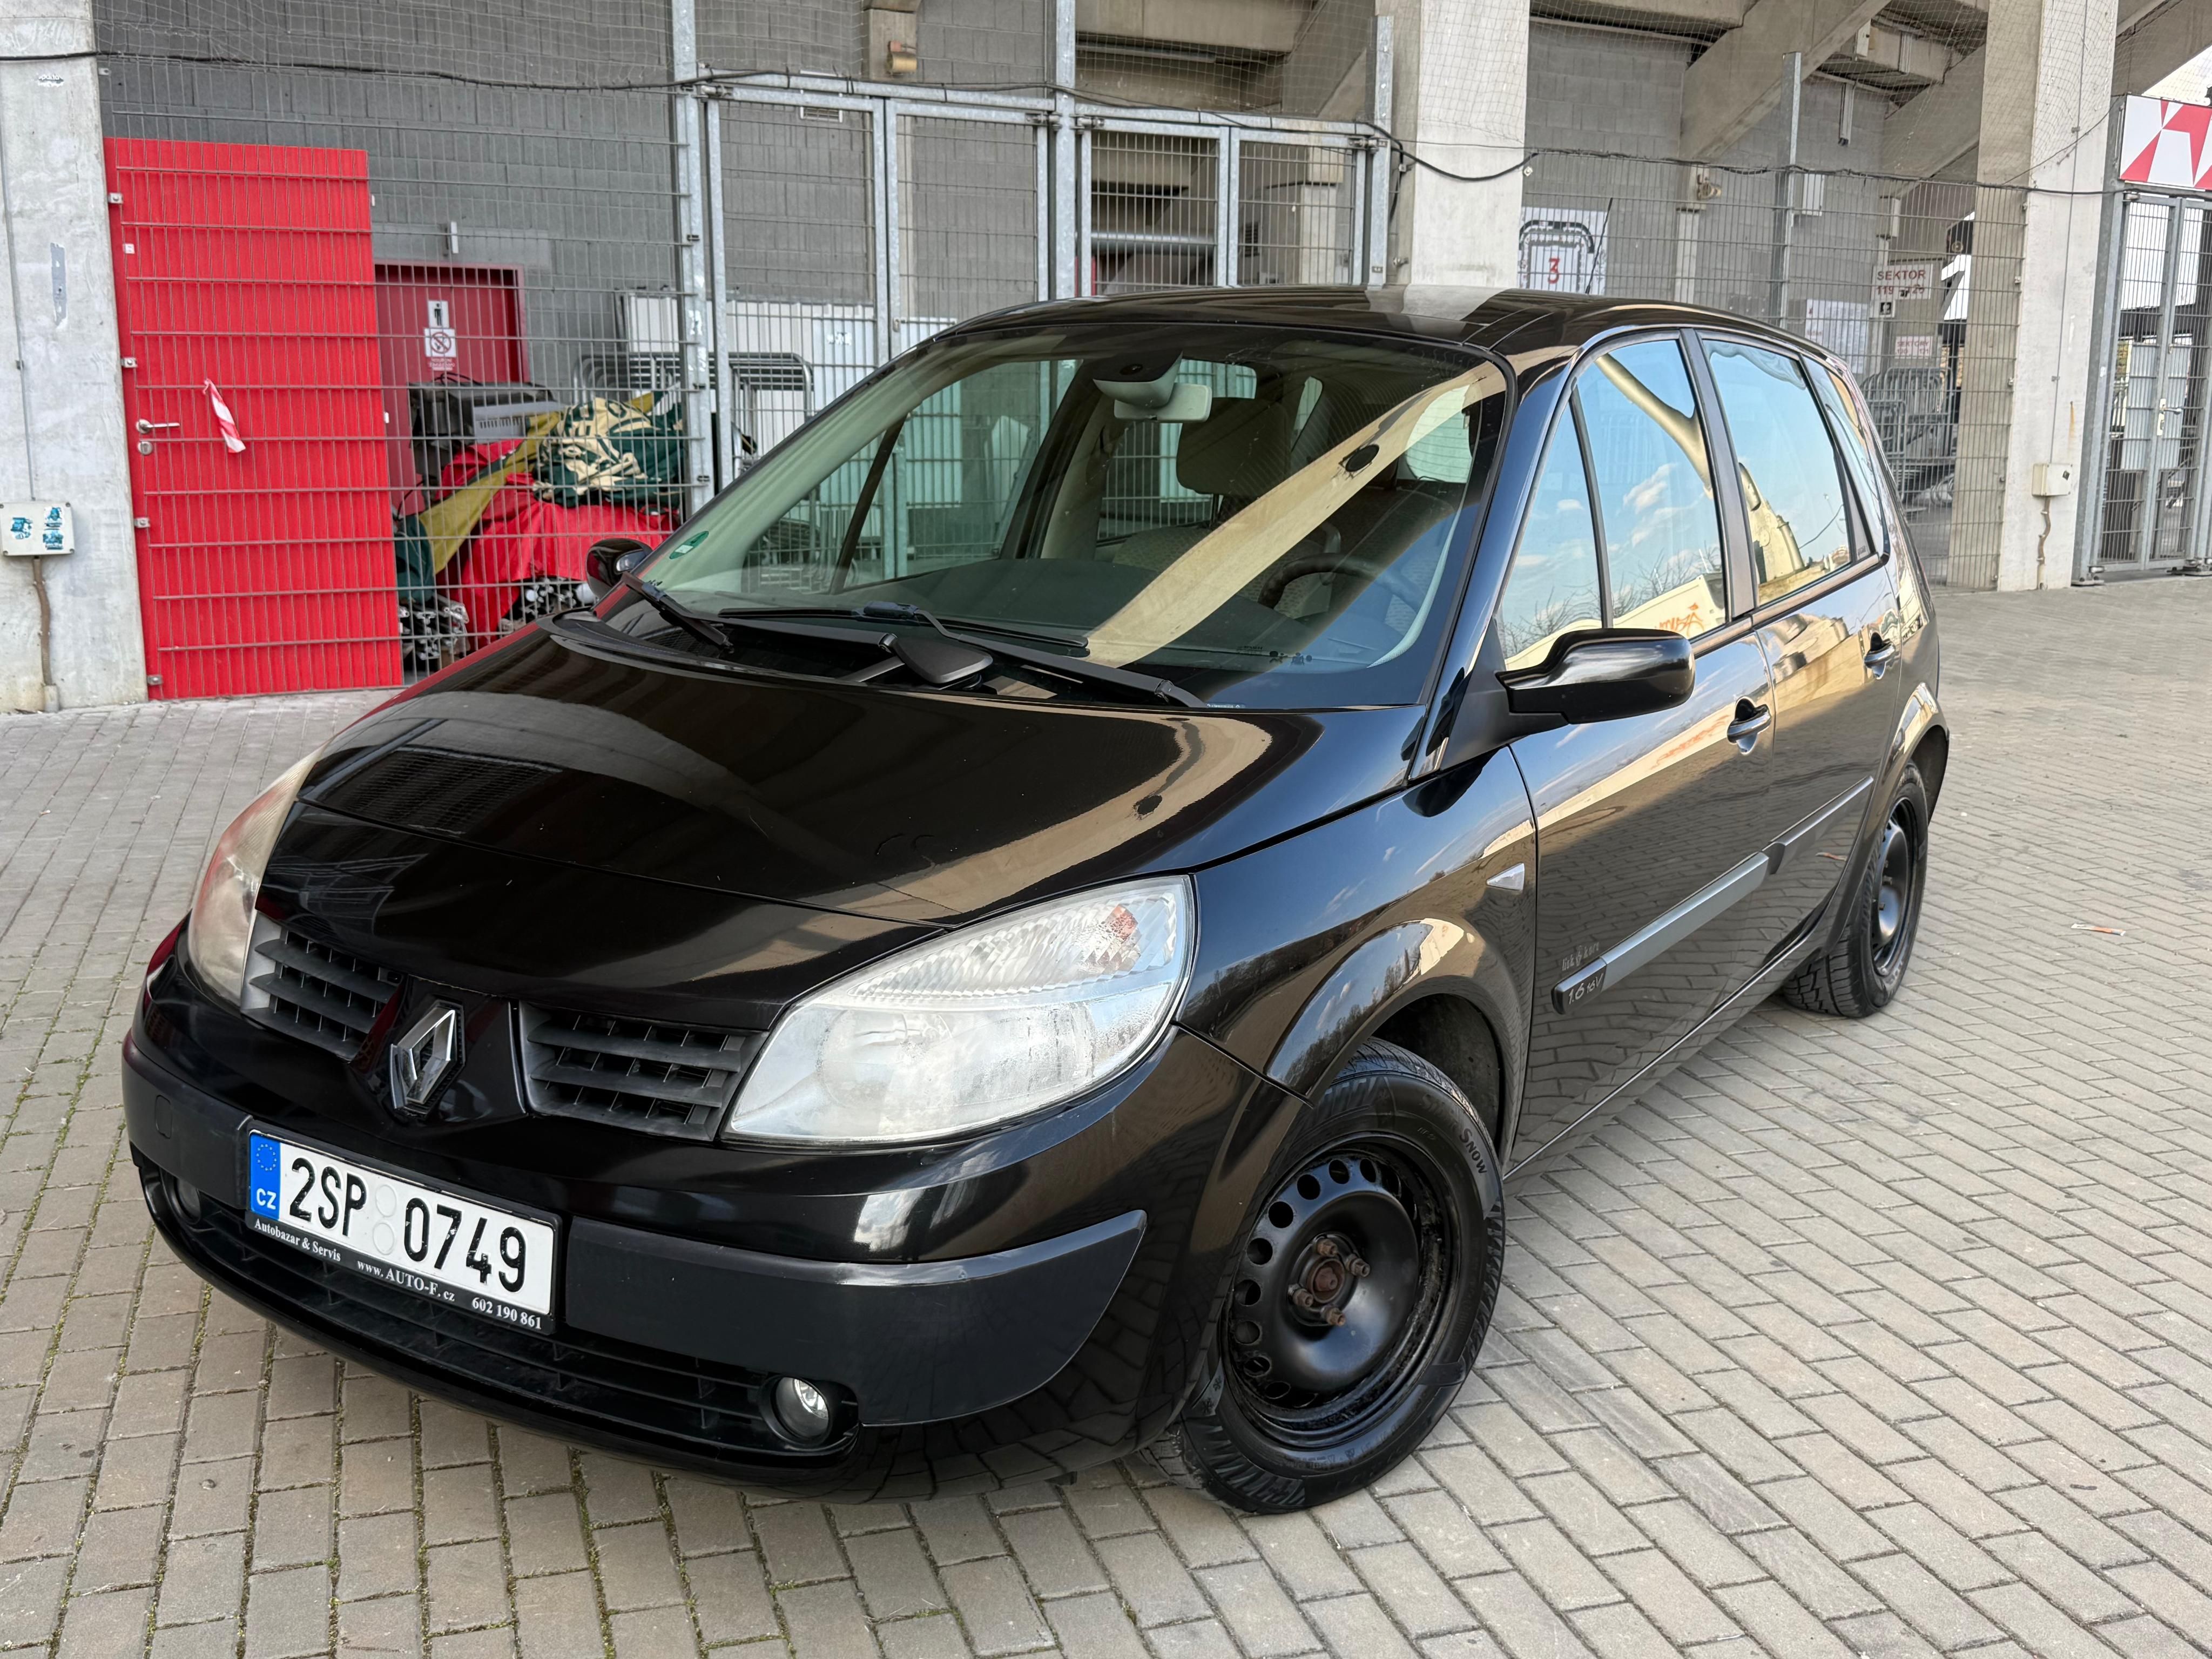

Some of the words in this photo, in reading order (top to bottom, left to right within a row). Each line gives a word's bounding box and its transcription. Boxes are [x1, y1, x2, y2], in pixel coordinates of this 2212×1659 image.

[1877, 269, 1926, 280] SEKTOR
[1568, 983, 1585, 1004] 1.6
[256, 1188, 276, 1210] CZ
[289, 1157, 367, 1237] 2SP
[403, 1197, 527, 1293] 0749
[254, 1218, 300, 1246] Autobazar
[302, 1237, 310, 1250] &
[312, 1240, 341, 1262] Servis
[471, 1297, 493, 1314] 602
[496, 1305, 517, 1322] 190
[520, 1312, 542, 1330] 861
